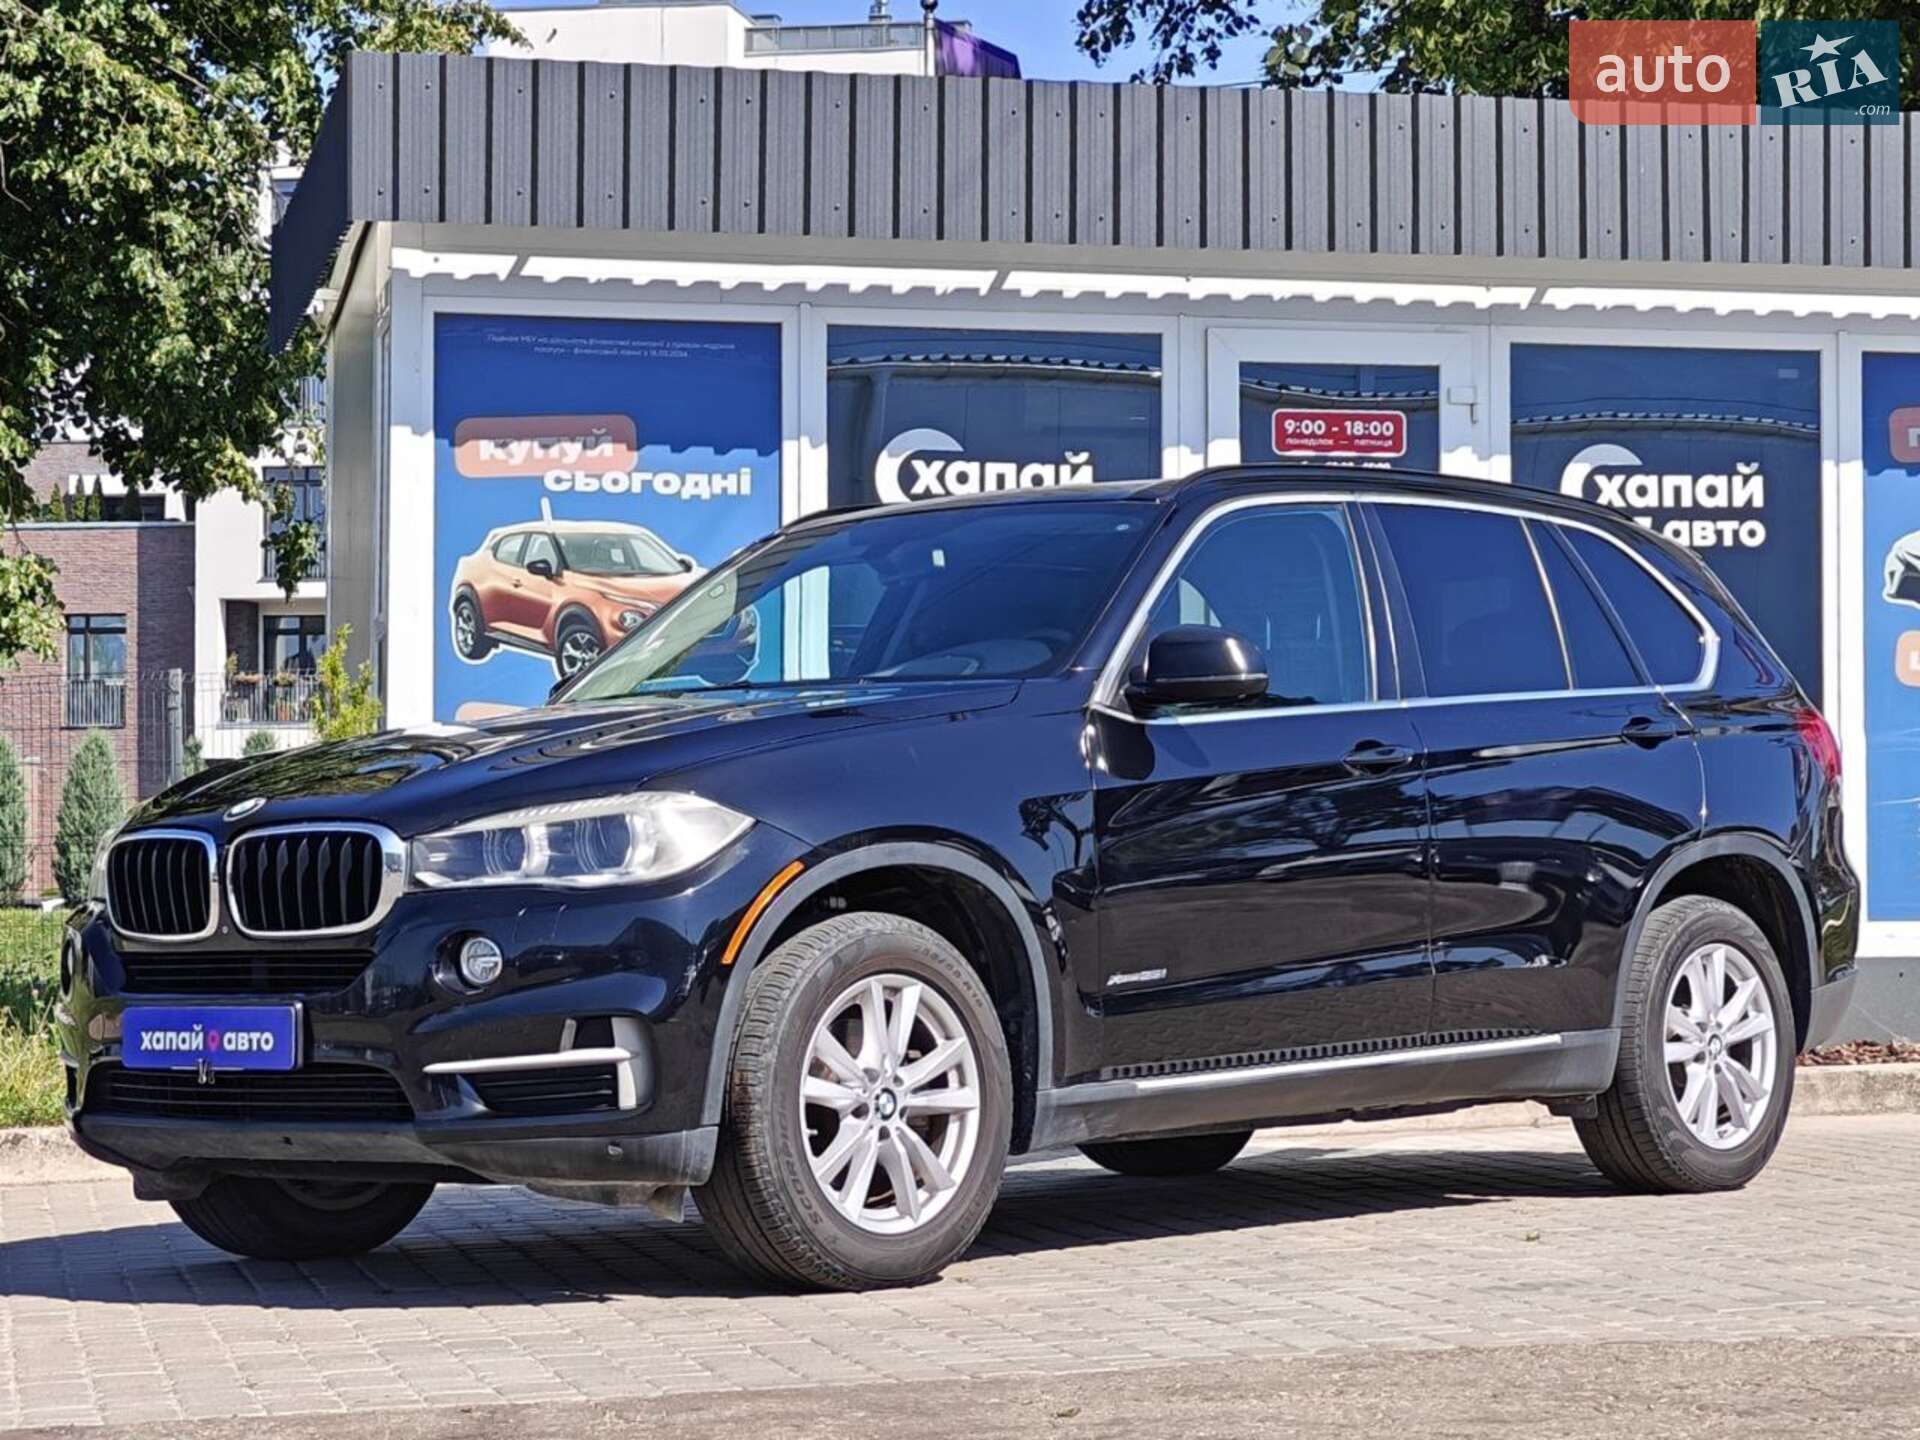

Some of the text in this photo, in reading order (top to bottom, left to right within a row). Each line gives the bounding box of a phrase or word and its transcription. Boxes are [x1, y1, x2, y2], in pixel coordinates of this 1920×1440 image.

[1284, 419, 1326, 435] 9:00
[1344, 421, 1394, 436] 18:00
[479, 428, 614, 465] купуй
[543, 467, 752, 499] сьогодні
[1663, 520, 1766, 547] авто
[140, 1024, 274, 1051] хапай авто
